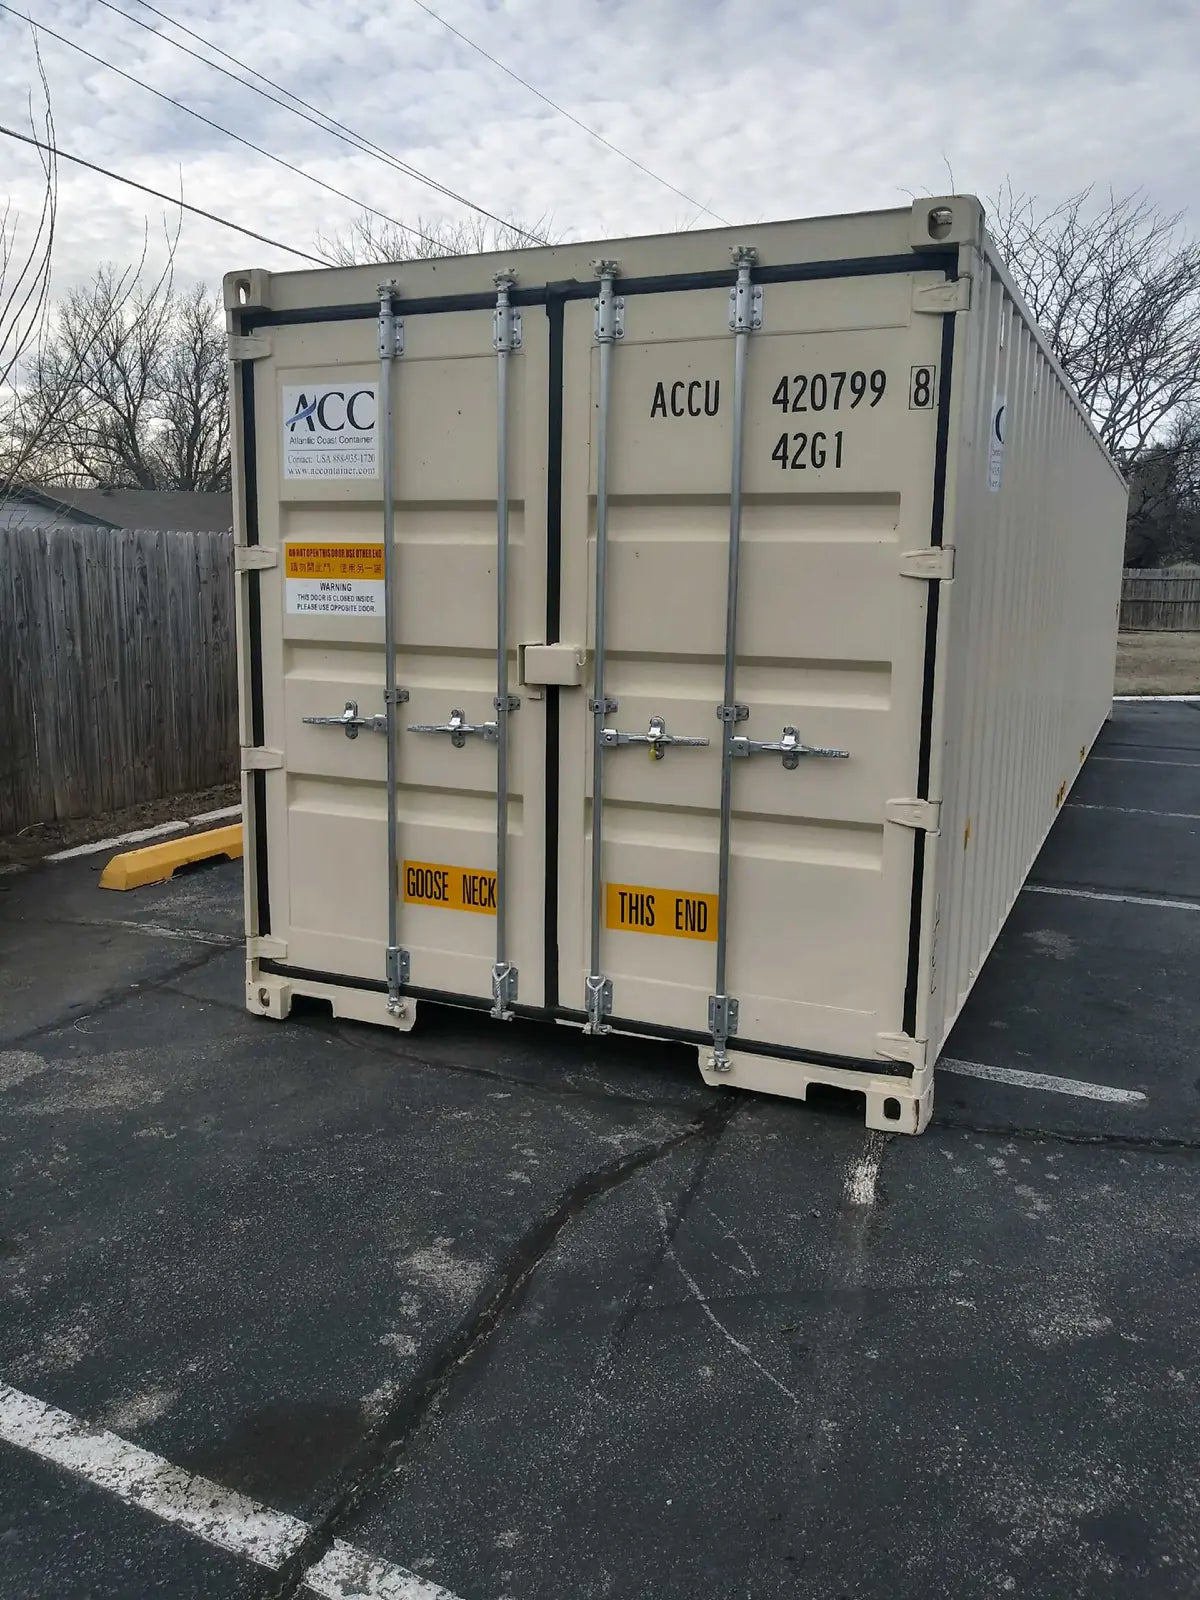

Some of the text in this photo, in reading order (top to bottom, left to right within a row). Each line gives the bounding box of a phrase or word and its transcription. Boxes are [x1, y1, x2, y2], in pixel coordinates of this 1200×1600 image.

[650, 367, 932, 418] ACCU 420799 8
[286, 391, 375, 431] ACC
[289, 435, 373, 445] Atlantic Coast Container
[771, 430, 844, 470] 42G1
[316, 455, 331, 463] USA
[306, 549, 320, 557] OPEN
[320, 549, 330, 557] THIS
[356, 549, 373, 558] OTHER
[373, 549, 382, 558] END
[320, 583, 352, 592] WARNING
[297, 603, 318, 611] PLEASE
[330, 604, 357, 612] OPPOSITE
[407, 867, 497, 908] GOOSE NECK
[618, 891, 708, 933] THIS END
